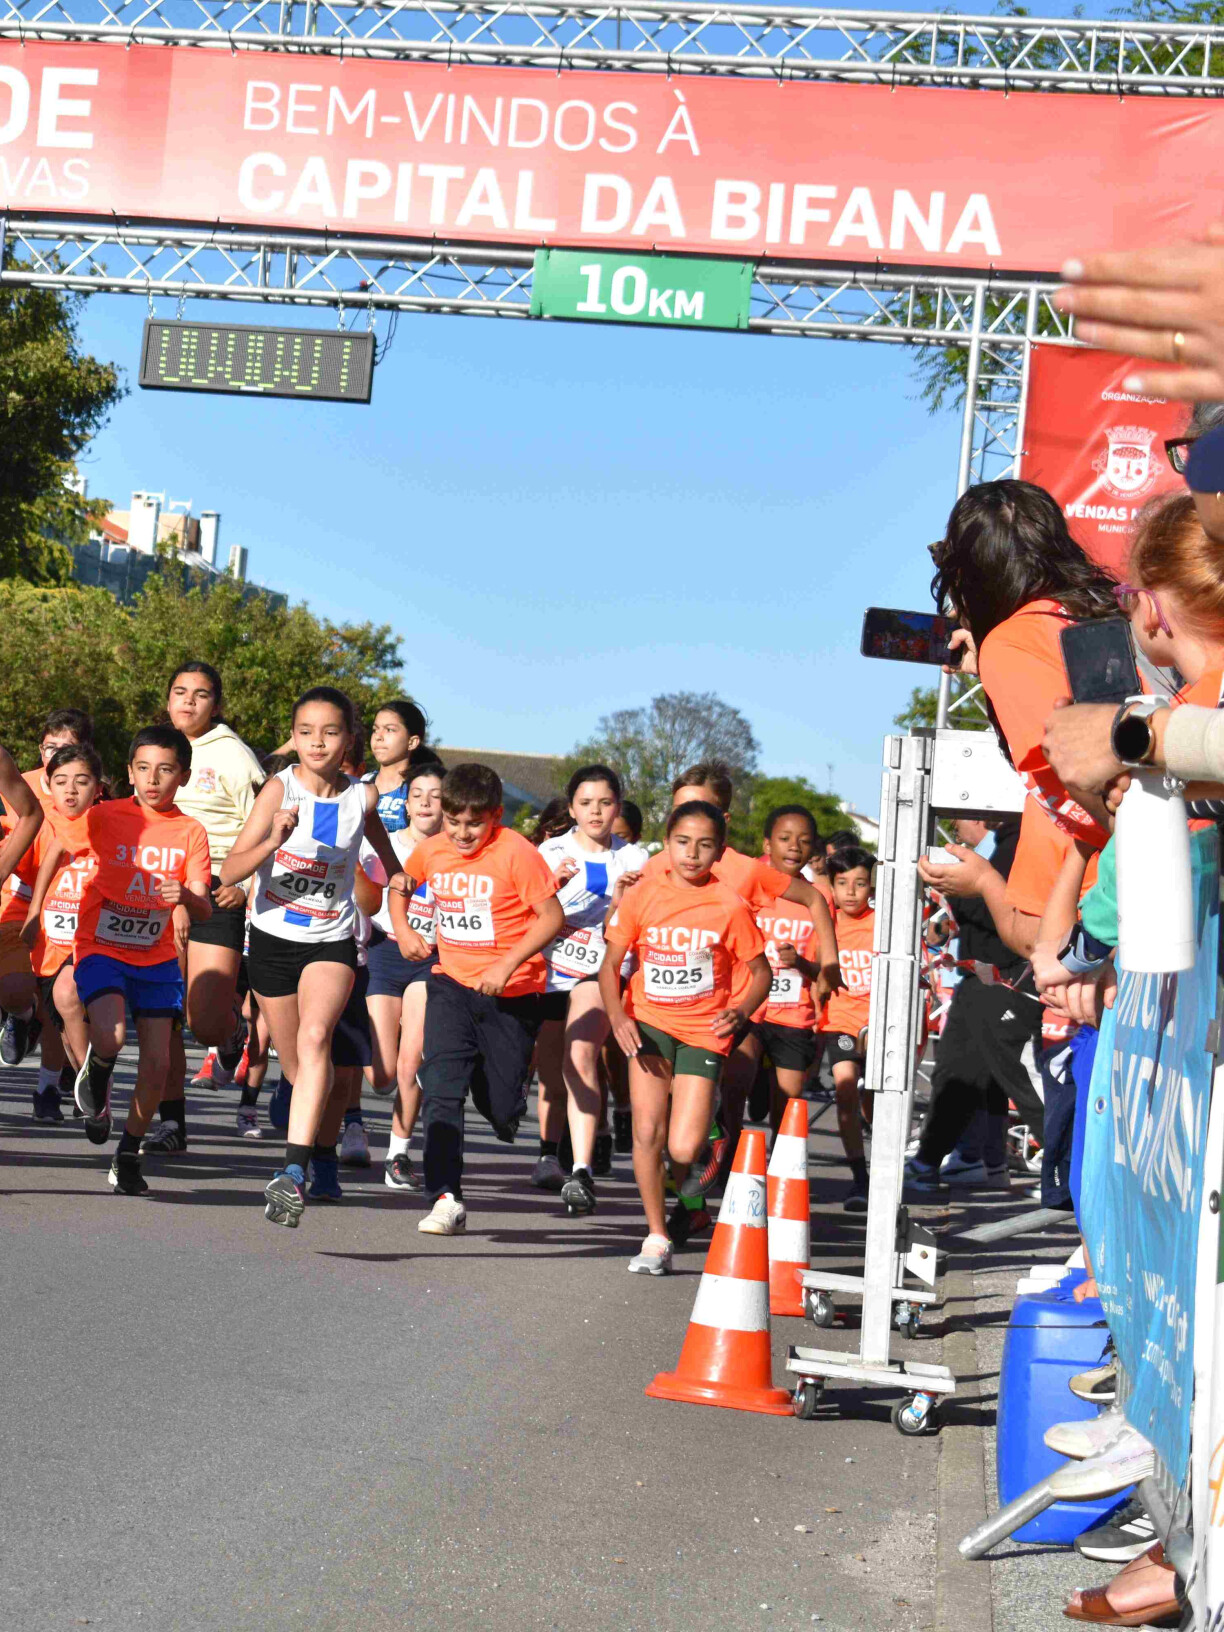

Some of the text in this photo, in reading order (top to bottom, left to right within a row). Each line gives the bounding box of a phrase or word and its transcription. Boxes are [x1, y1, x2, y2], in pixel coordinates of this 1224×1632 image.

[243, 80, 701, 156] BEM-VINDOS À
[237, 151, 1003, 256] CAPITAL DA BIFANA
[1065, 504, 1127, 521] VENDAS
[290, 858, 326, 874] CIDADE
[126, 872, 165, 896] AD
[279, 872, 336, 899] 2078
[452, 872, 493, 898] CID
[409, 902, 433, 914] IDADE
[107, 915, 161, 935] 2070
[439, 913, 482, 930] 2146
[552, 938, 599, 964] 2093
[654, 952, 684, 962] CIDADE
[838, 949, 873, 969] CID
[651, 967, 702, 985] 2025
